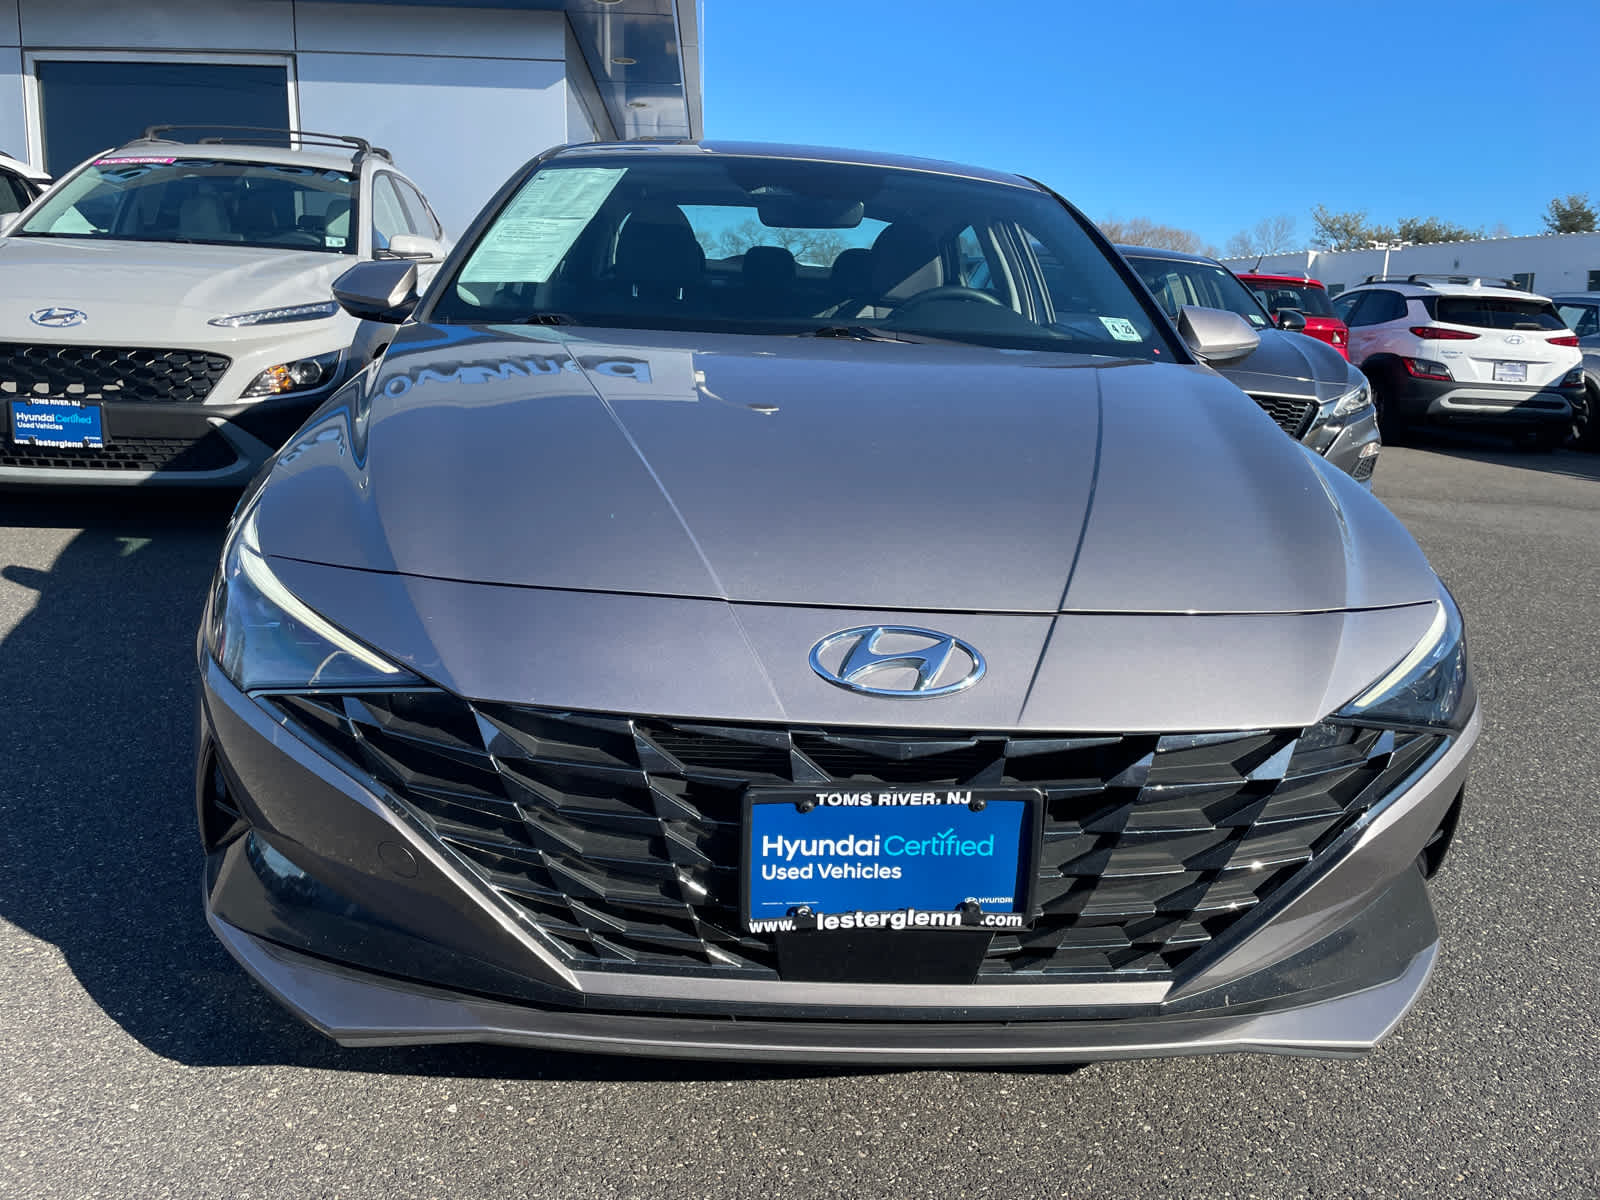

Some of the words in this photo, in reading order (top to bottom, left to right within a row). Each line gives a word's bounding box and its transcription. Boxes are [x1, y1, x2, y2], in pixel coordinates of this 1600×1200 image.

[16, 412, 55, 422] Hyundai
[55, 413, 92, 424] Certified
[35, 422, 63, 430] Vehicles
[35, 438, 83, 449] lesterglenn
[816, 791, 872, 806] TOMS
[878, 791, 942, 806] RIVER,
[947, 790, 972, 805] NJ
[761, 834, 881, 861] Hyundai
[884, 828, 995, 857] Certified
[761, 863, 813, 881] Used
[817, 862, 902, 880] Vehicles
[748, 919, 797, 934] www.
[816, 907, 962, 931] lesterglenn
[979, 914, 1023, 927] .com
